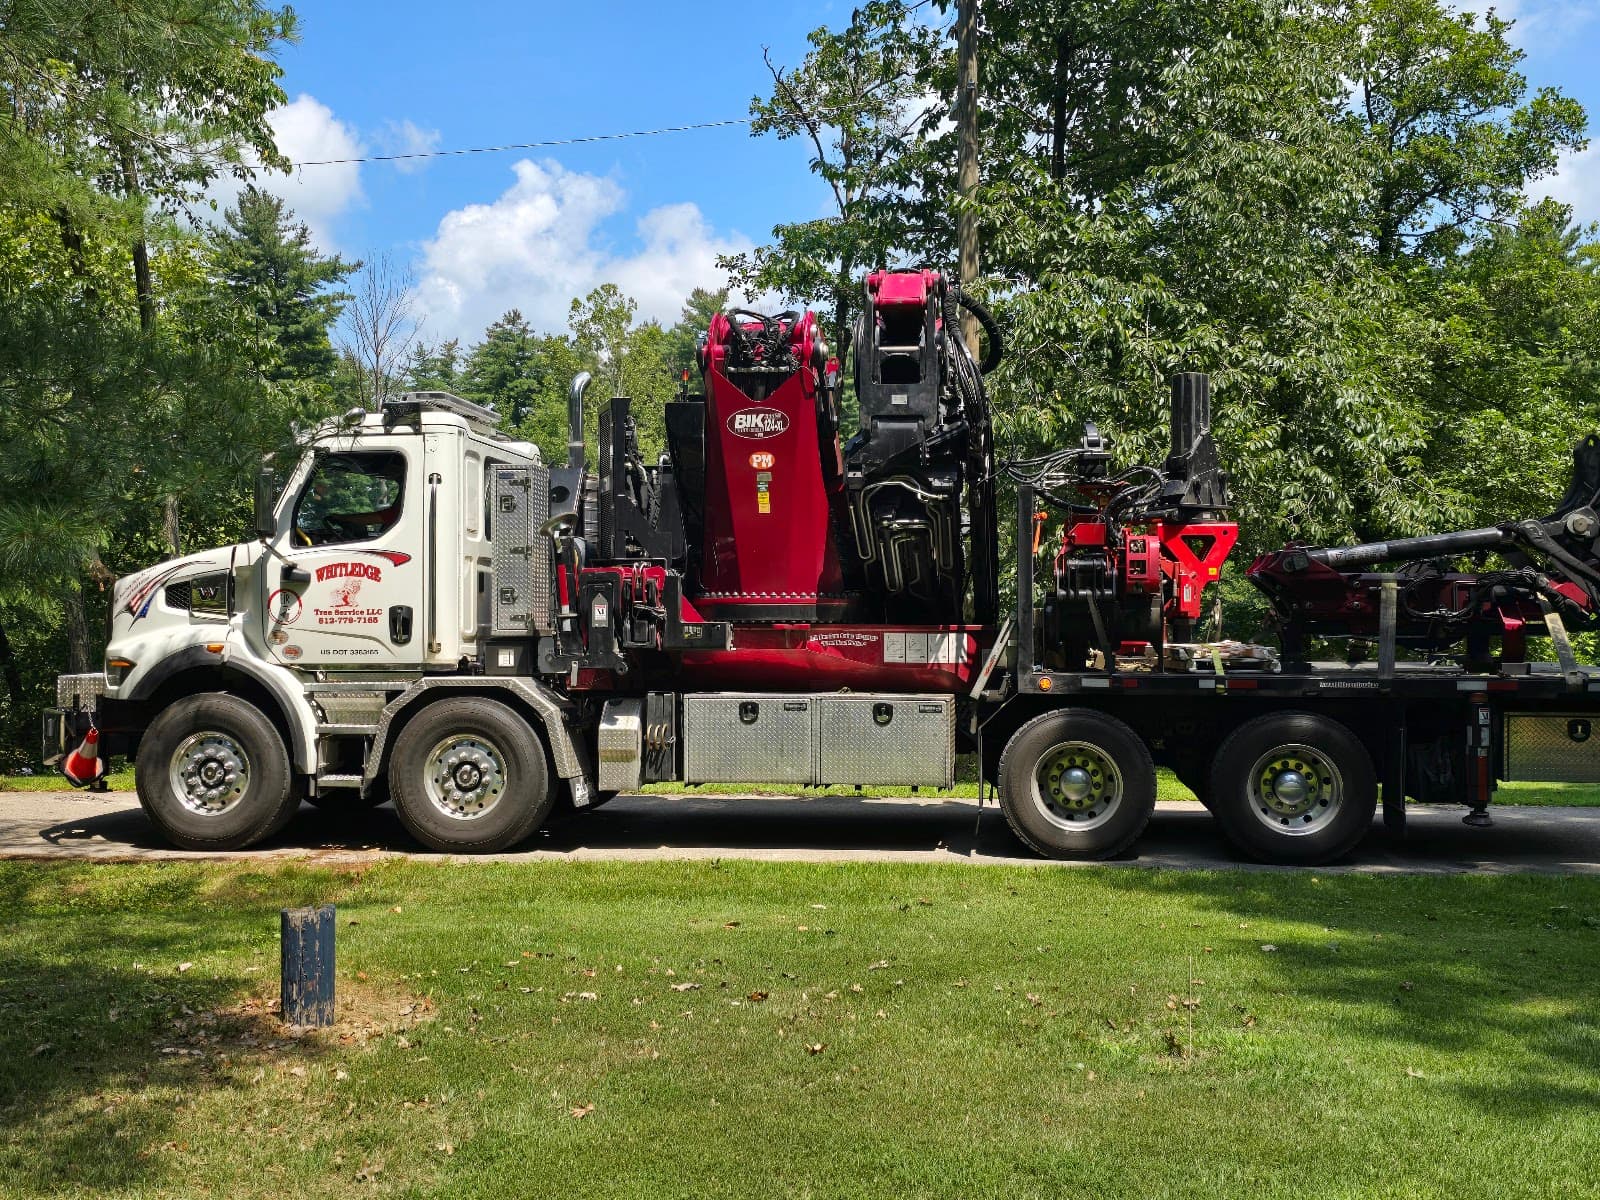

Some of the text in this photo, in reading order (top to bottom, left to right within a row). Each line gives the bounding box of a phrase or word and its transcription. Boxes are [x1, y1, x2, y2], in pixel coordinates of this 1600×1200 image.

[735, 414, 764, 428] BIK
[751, 454, 772, 468] PM
[315, 562, 382, 583] WHITLEDGE
[313, 608, 333, 616] Tree
